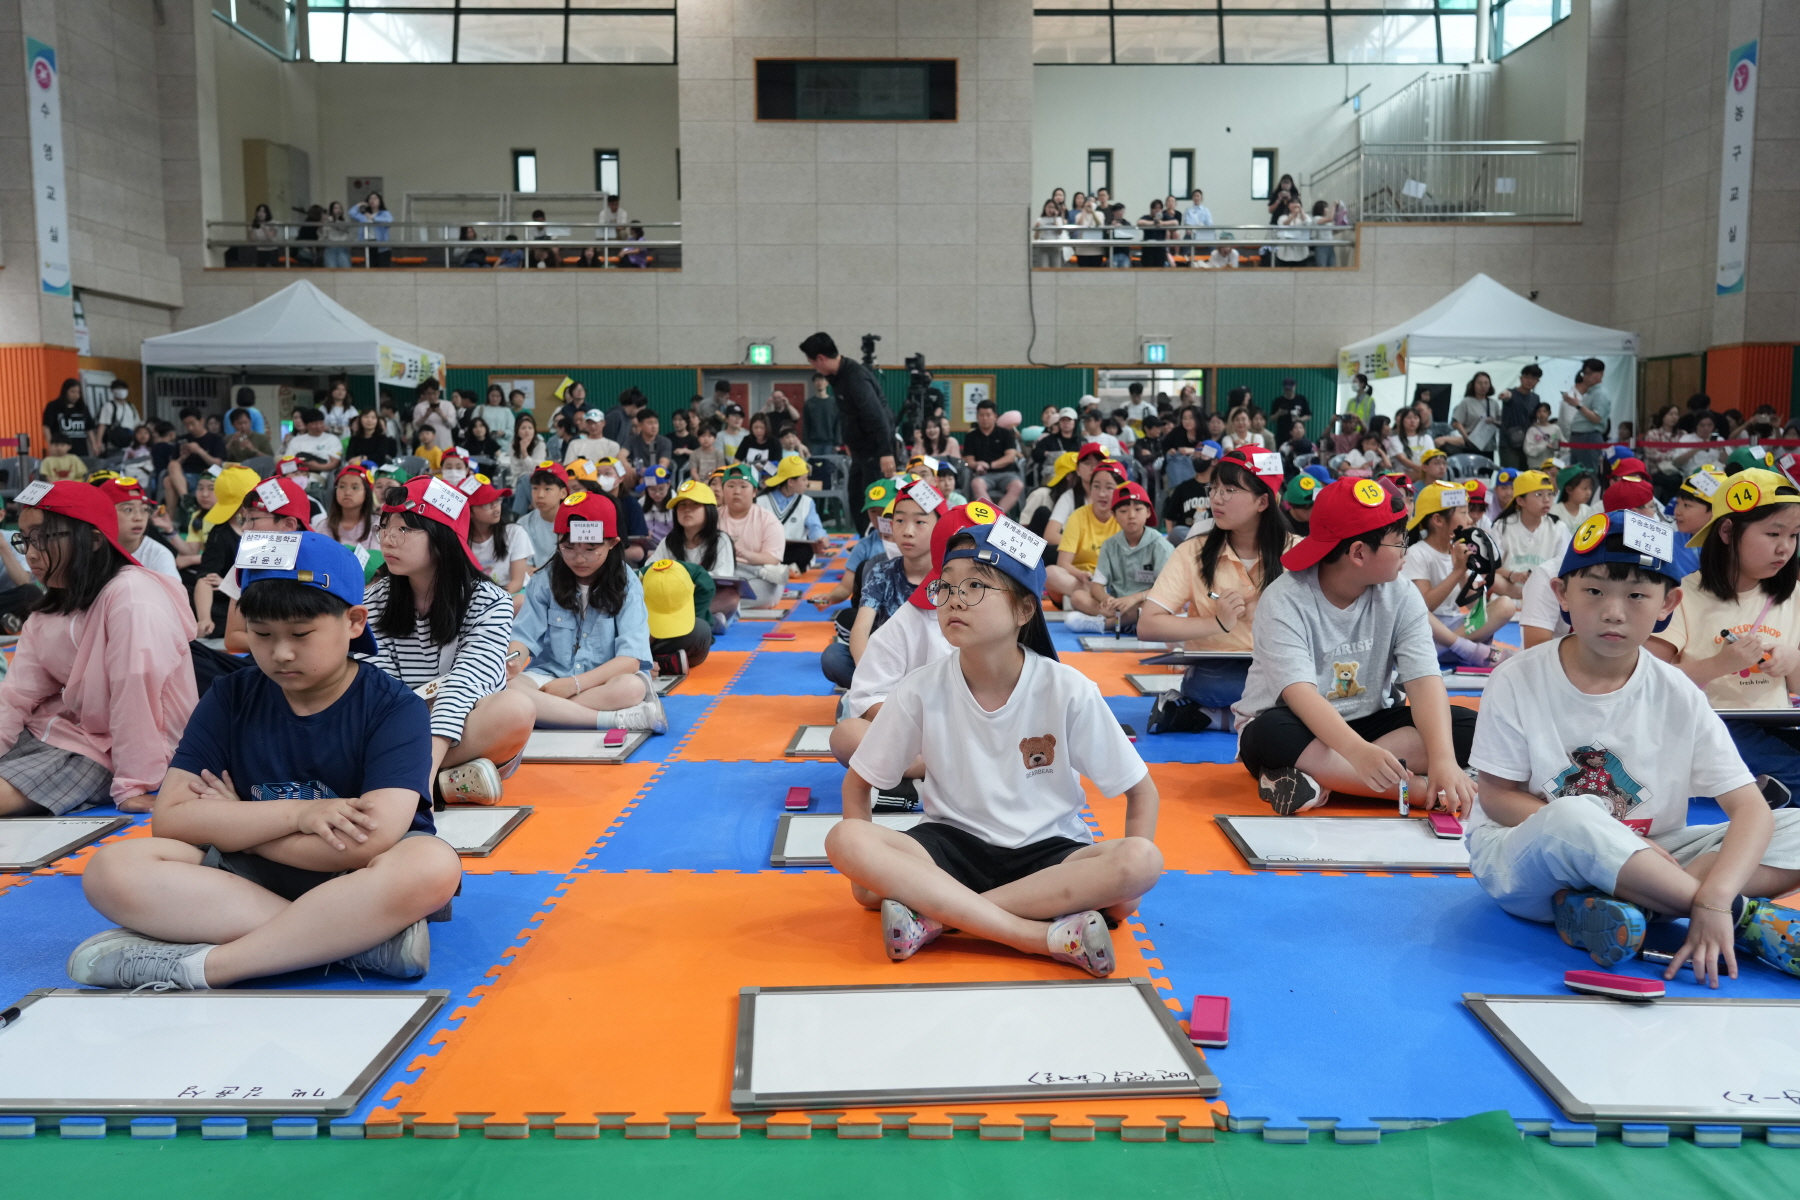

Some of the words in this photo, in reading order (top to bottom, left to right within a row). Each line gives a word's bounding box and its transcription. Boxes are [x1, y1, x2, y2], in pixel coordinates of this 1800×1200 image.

[1361, 485, 1379, 499] 15
[1733, 488, 1753, 505] 14
[975, 507, 988, 518] 16
[1582, 525, 1596, 542] 5
[1642, 532, 1656, 542] 4-2
[1010, 536, 1024, 548] 5-1
[1757, 625, 1782, 639] SHOP
